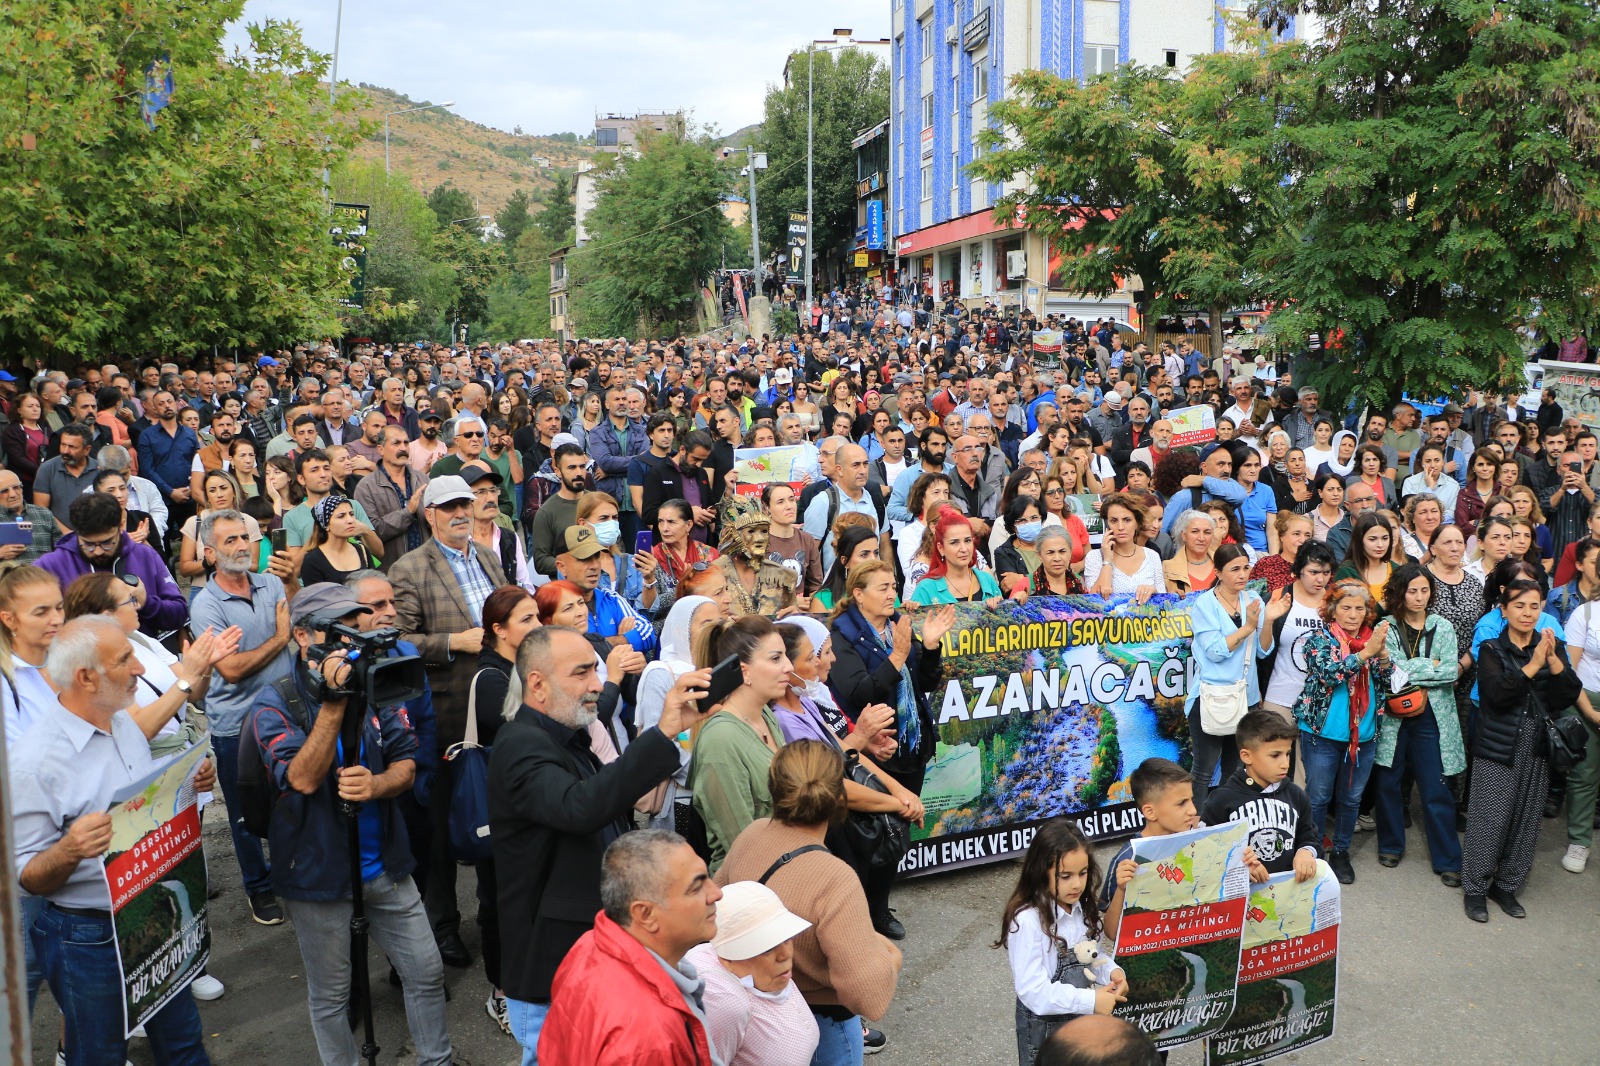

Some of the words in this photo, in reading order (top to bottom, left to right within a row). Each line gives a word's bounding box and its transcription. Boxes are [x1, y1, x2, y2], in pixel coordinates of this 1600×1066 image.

[1558, 374, 1586, 386] ATIK
[933, 647, 1195, 726] AZANACAĞI
[133, 823, 172, 858] DERSİM
[941, 835, 986, 864] EMEK
[987, 831, 1009, 854] VE
[1284, 838, 1294, 851] 67
[117, 860, 149, 888] DOĞA
[152, 824, 191, 862] MİTİNGİ
[1134, 924, 1171, 938] DOĞA
[1177, 913, 1230, 931] MİTİNGİ
[1160, 905, 1211, 921] DERSİM
[1125, 943, 1142, 953] EKİM
[1142, 941, 1158, 951] 2022
[1180, 934, 1198, 944] SEYİT
[1198, 931, 1214, 941] RIZA
[1214, 927, 1241, 939] MEYDANI
[1251, 938, 1303, 957] DERSİM
[1272, 939, 1325, 963] MİTİNGİ
[1275, 963, 1294, 973] SEYİT
[1294, 960, 1309, 969] RIZA
[1310, 948, 1336, 963] MEYDANI
[125, 962, 146, 985] YAŞAM
[131, 973, 151, 1004] BİZ
[1112, 1005, 1134, 1017] AŞAM
[1134, 997, 1186, 1012] ALANLARIMIZI
[1138, 1000, 1228, 1033] KAZANACAĞIZ!
[1210, 1030, 1237, 1040] YAŞAM
[1237, 1016, 1287, 1035] ALANLARIMIZI
[1217, 1035, 1239, 1056] BİZ
[1242, 1010, 1329, 1051] KAZANACAĞIZ!
[1159, 1035, 1190, 1047] DEMOKRASİ
[1242, 1056, 1257, 1064] EMEK
[1265, 1043, 1294, 1058] DEMOKRASİ
[1294, 1033, 1324, 1048] PLATFORMU
